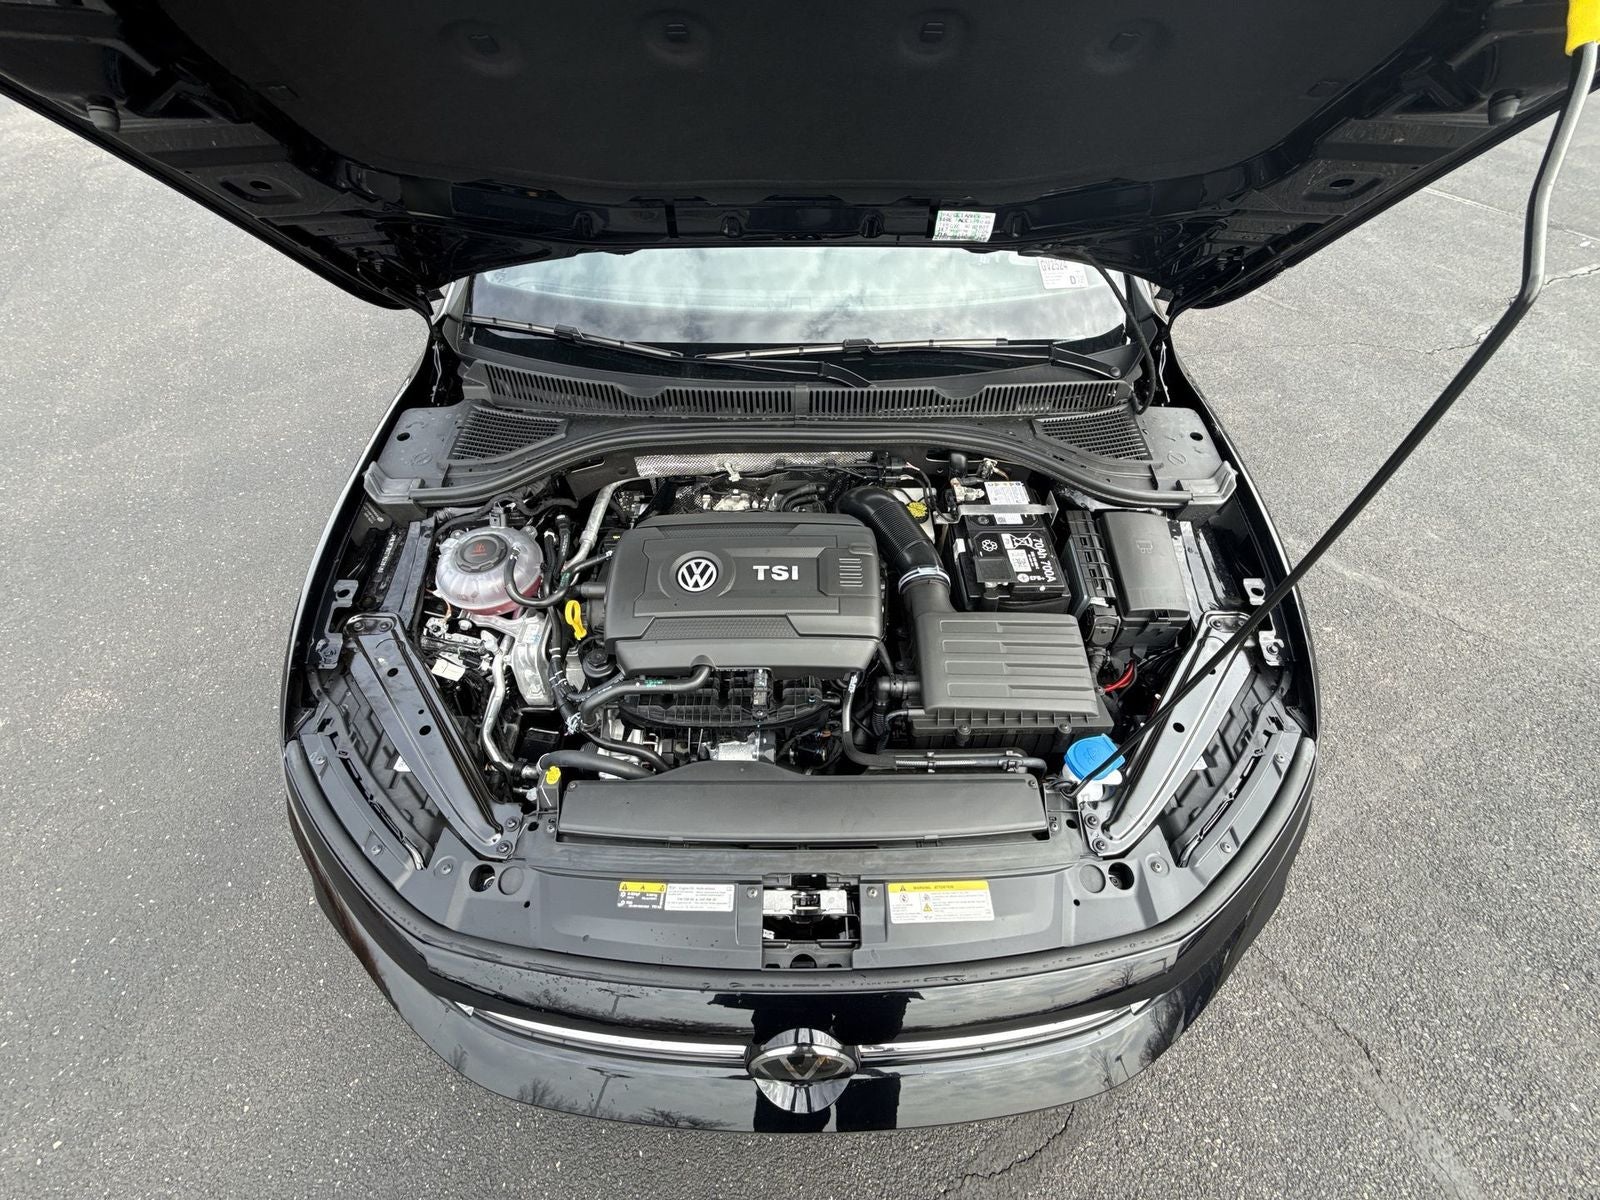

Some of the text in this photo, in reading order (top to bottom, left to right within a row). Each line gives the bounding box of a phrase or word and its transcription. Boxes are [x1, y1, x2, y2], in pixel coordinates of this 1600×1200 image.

[752, 565, 799, 581] TSI
[1032, 538, 1048, 559] 70Ah
[1040, 560, 1057, 583] 700A
